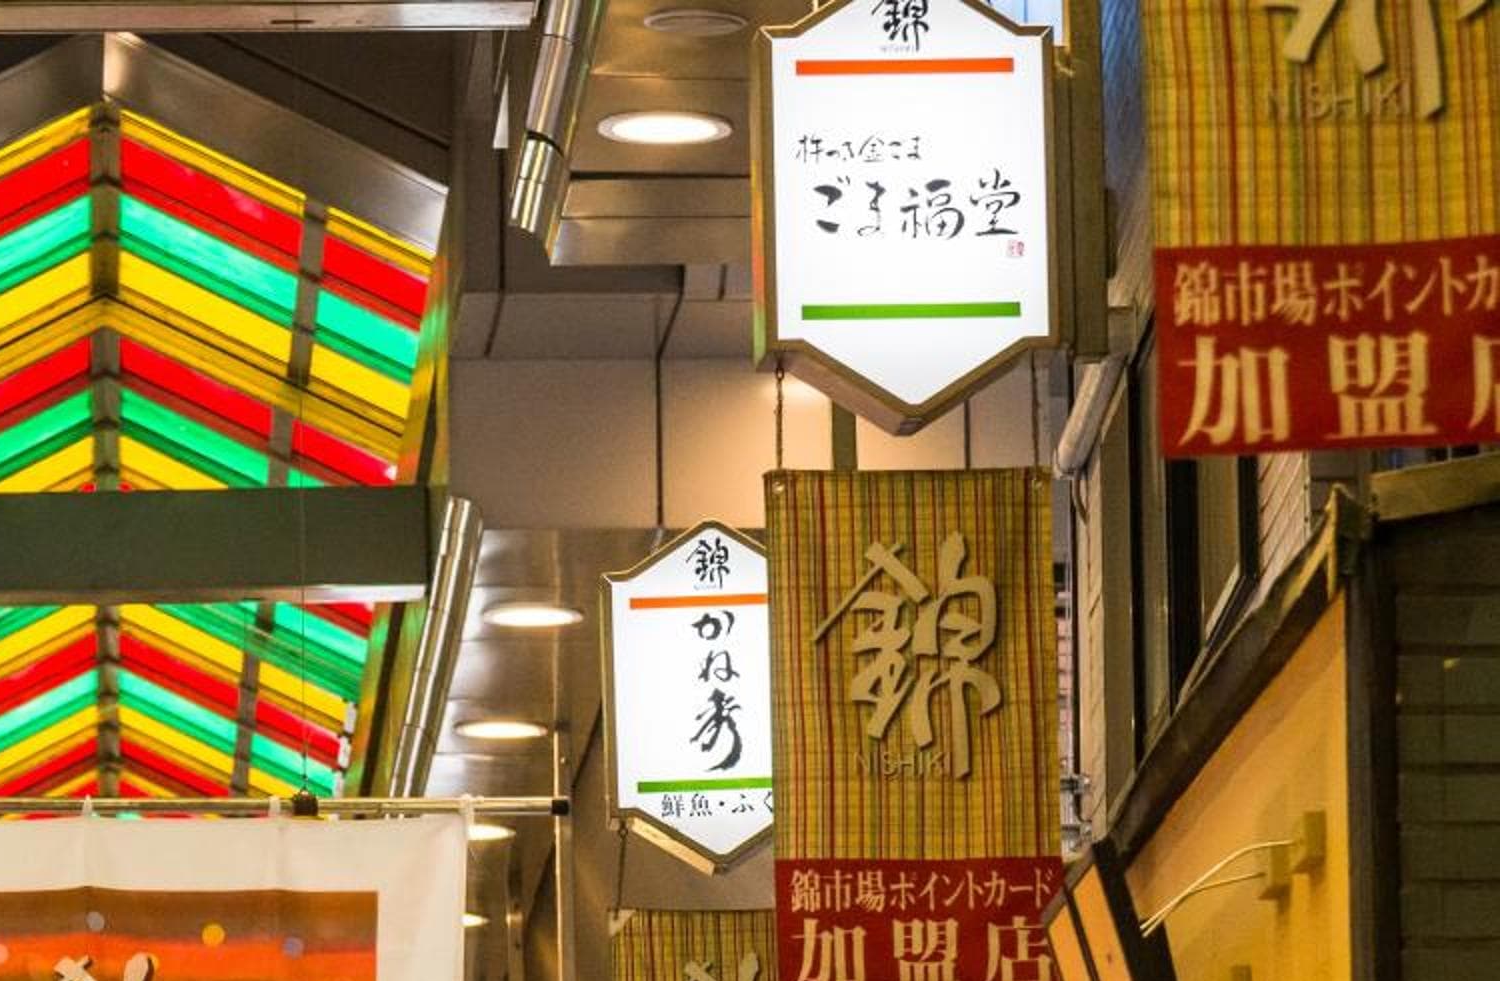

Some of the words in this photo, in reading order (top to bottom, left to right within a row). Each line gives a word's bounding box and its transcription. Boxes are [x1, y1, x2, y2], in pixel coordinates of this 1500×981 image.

[871, 0, 929, 51] 錦
[812, 167, 1022, 241] ごま福堂
[685, 536, 732, 589] 錦
[813, 529, 1002, 779] 錦
[790, 866, 1055, 914] 錦市場ポイントカード
